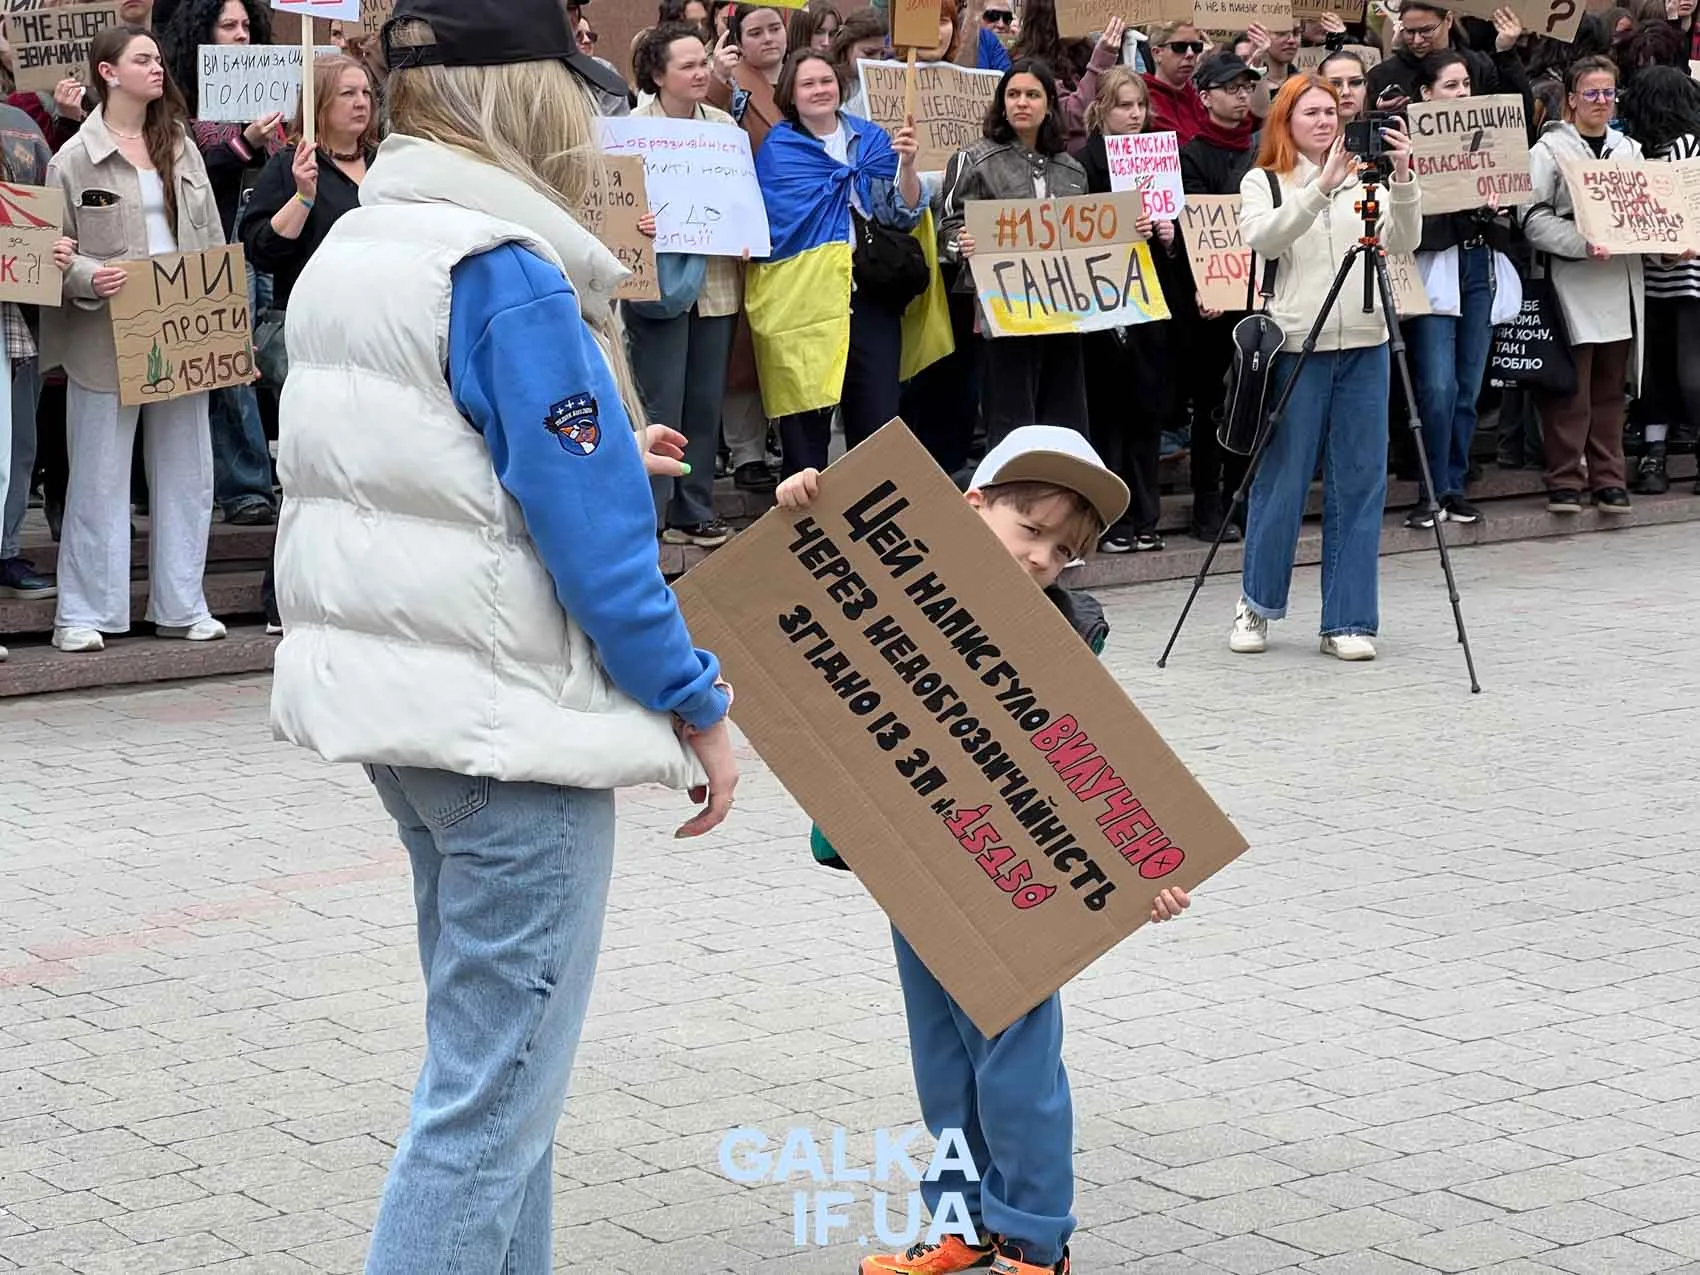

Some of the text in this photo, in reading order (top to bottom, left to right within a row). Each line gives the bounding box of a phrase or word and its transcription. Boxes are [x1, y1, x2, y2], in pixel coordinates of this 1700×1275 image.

[205, 81, 290, 108] ГОЛОСУ
[866, 67, 943, 91] ГРОМДА
[1418, 105, 1524, 136] СПАДЩИНА
[152, 252, 233, 305] МИ
[993, 247, 1149, 319] ГАНЬБА
[162, 306, 248, 344] ПРОТИ
[1492, 356, 1543, 370] РОБЛЮ
[1495, 341, 1519, 354] ТАК
[179, 351, 253, 390] 15150
[842, 479, 1186, 880] ЦЕЙ НАПИС БУЛО ВИЛУЧЕНО
[778, 604, 881, 716] ЗГІДНО
[866, 711, 911, 751] ІЗ
[895, 748, 948, 797] ЗП
[788, 516, 1116, 911] ЧЕРЕЗ НЕДОБРОЗВИЧАЙНІСТЬ
